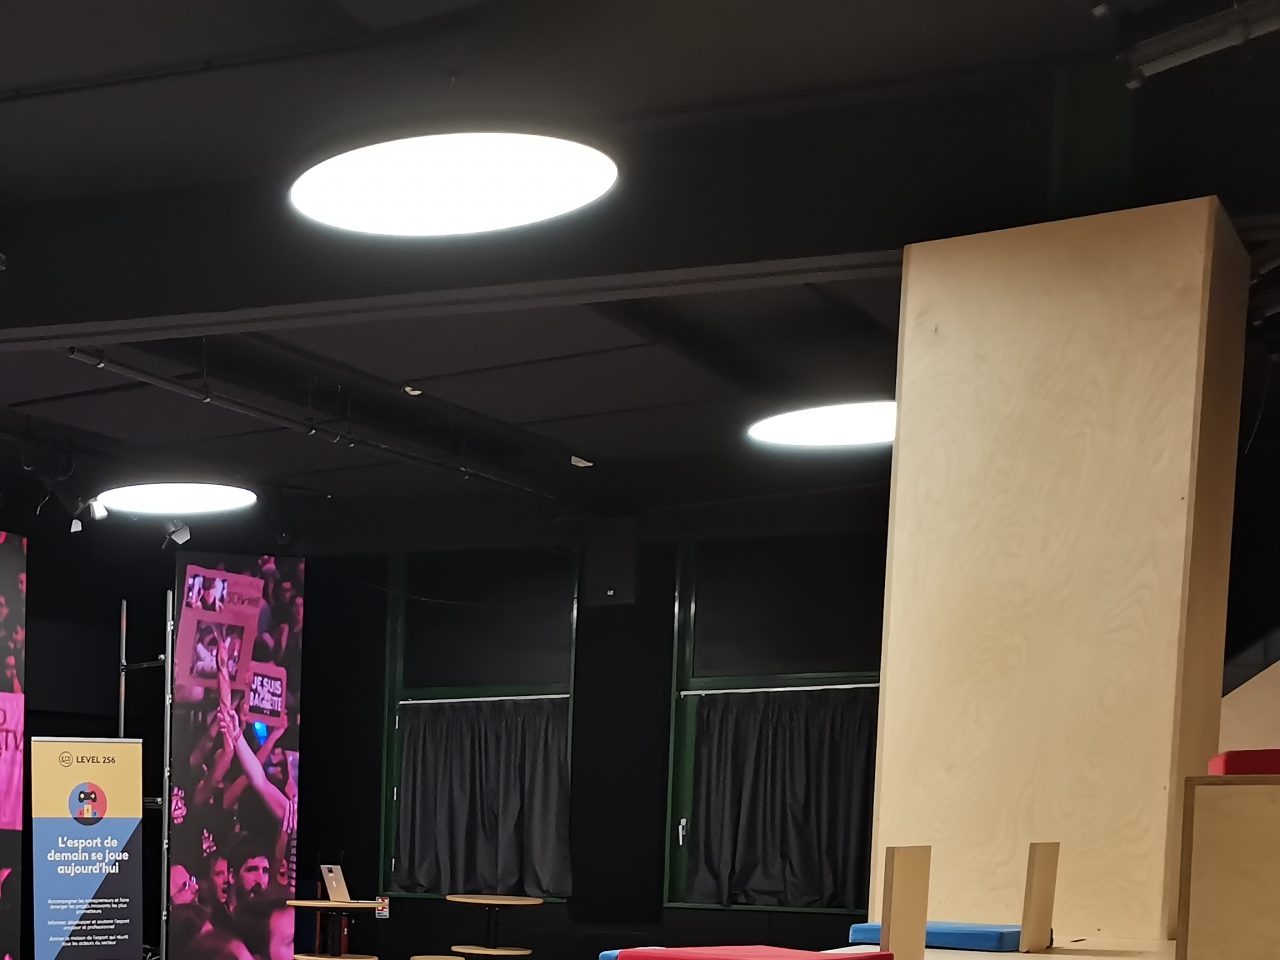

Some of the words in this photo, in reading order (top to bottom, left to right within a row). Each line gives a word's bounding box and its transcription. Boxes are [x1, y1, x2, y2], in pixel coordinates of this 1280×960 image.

[251, 676, 263, 690] JE
[76, 755, 101, 764] LEVEL
[102, 756, 116, 764] 256
[58, 836, 102, 850] L'esport
[104, 836, 118, 847] de
[47, 849, 89, 861] demain
[91, 852, 103, 860] se
[104, 849, 129, 863] joue
[57, 862, 119, 876] aujourd'hui
